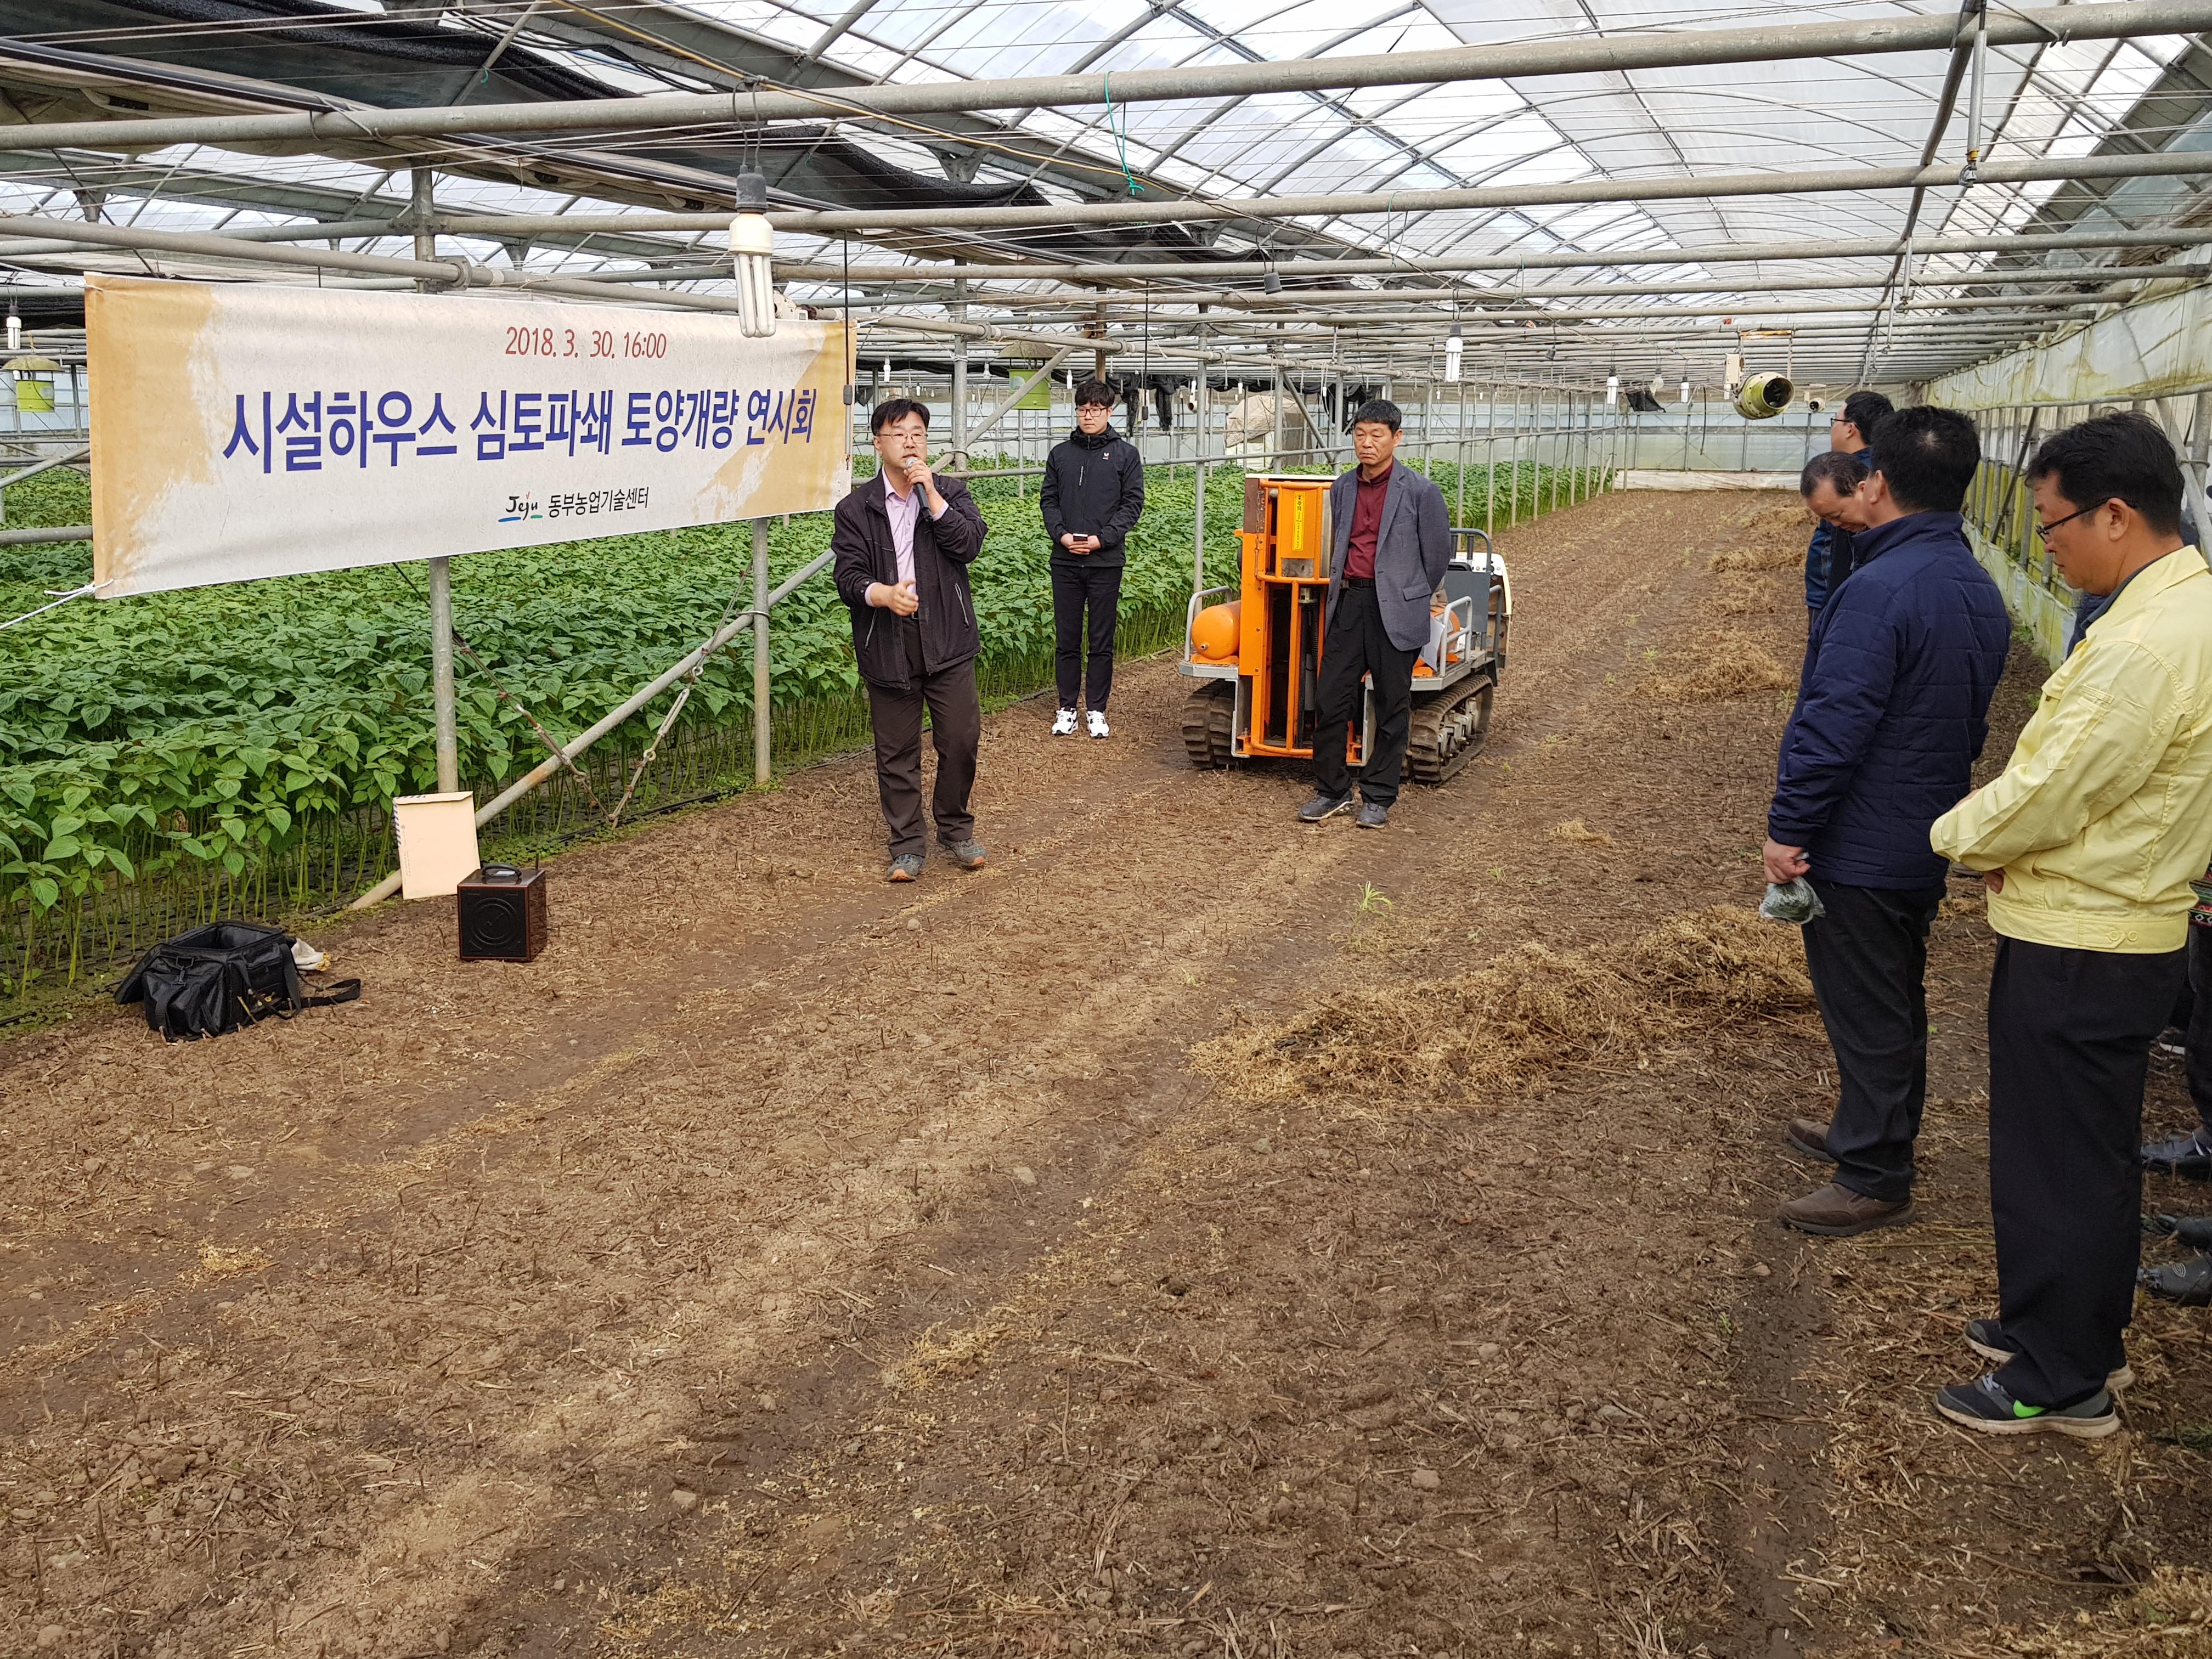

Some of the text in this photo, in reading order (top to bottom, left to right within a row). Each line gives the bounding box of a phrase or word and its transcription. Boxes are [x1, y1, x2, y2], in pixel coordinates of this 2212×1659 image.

[506, 326, 667, 359] 2018. 3. 30. 16:00
[223, 388, 817, 473] 시설하우스 심토파쇄 토양개량 연시회
[505, 486, 650, 521] Jeju 동부농업기술센터
